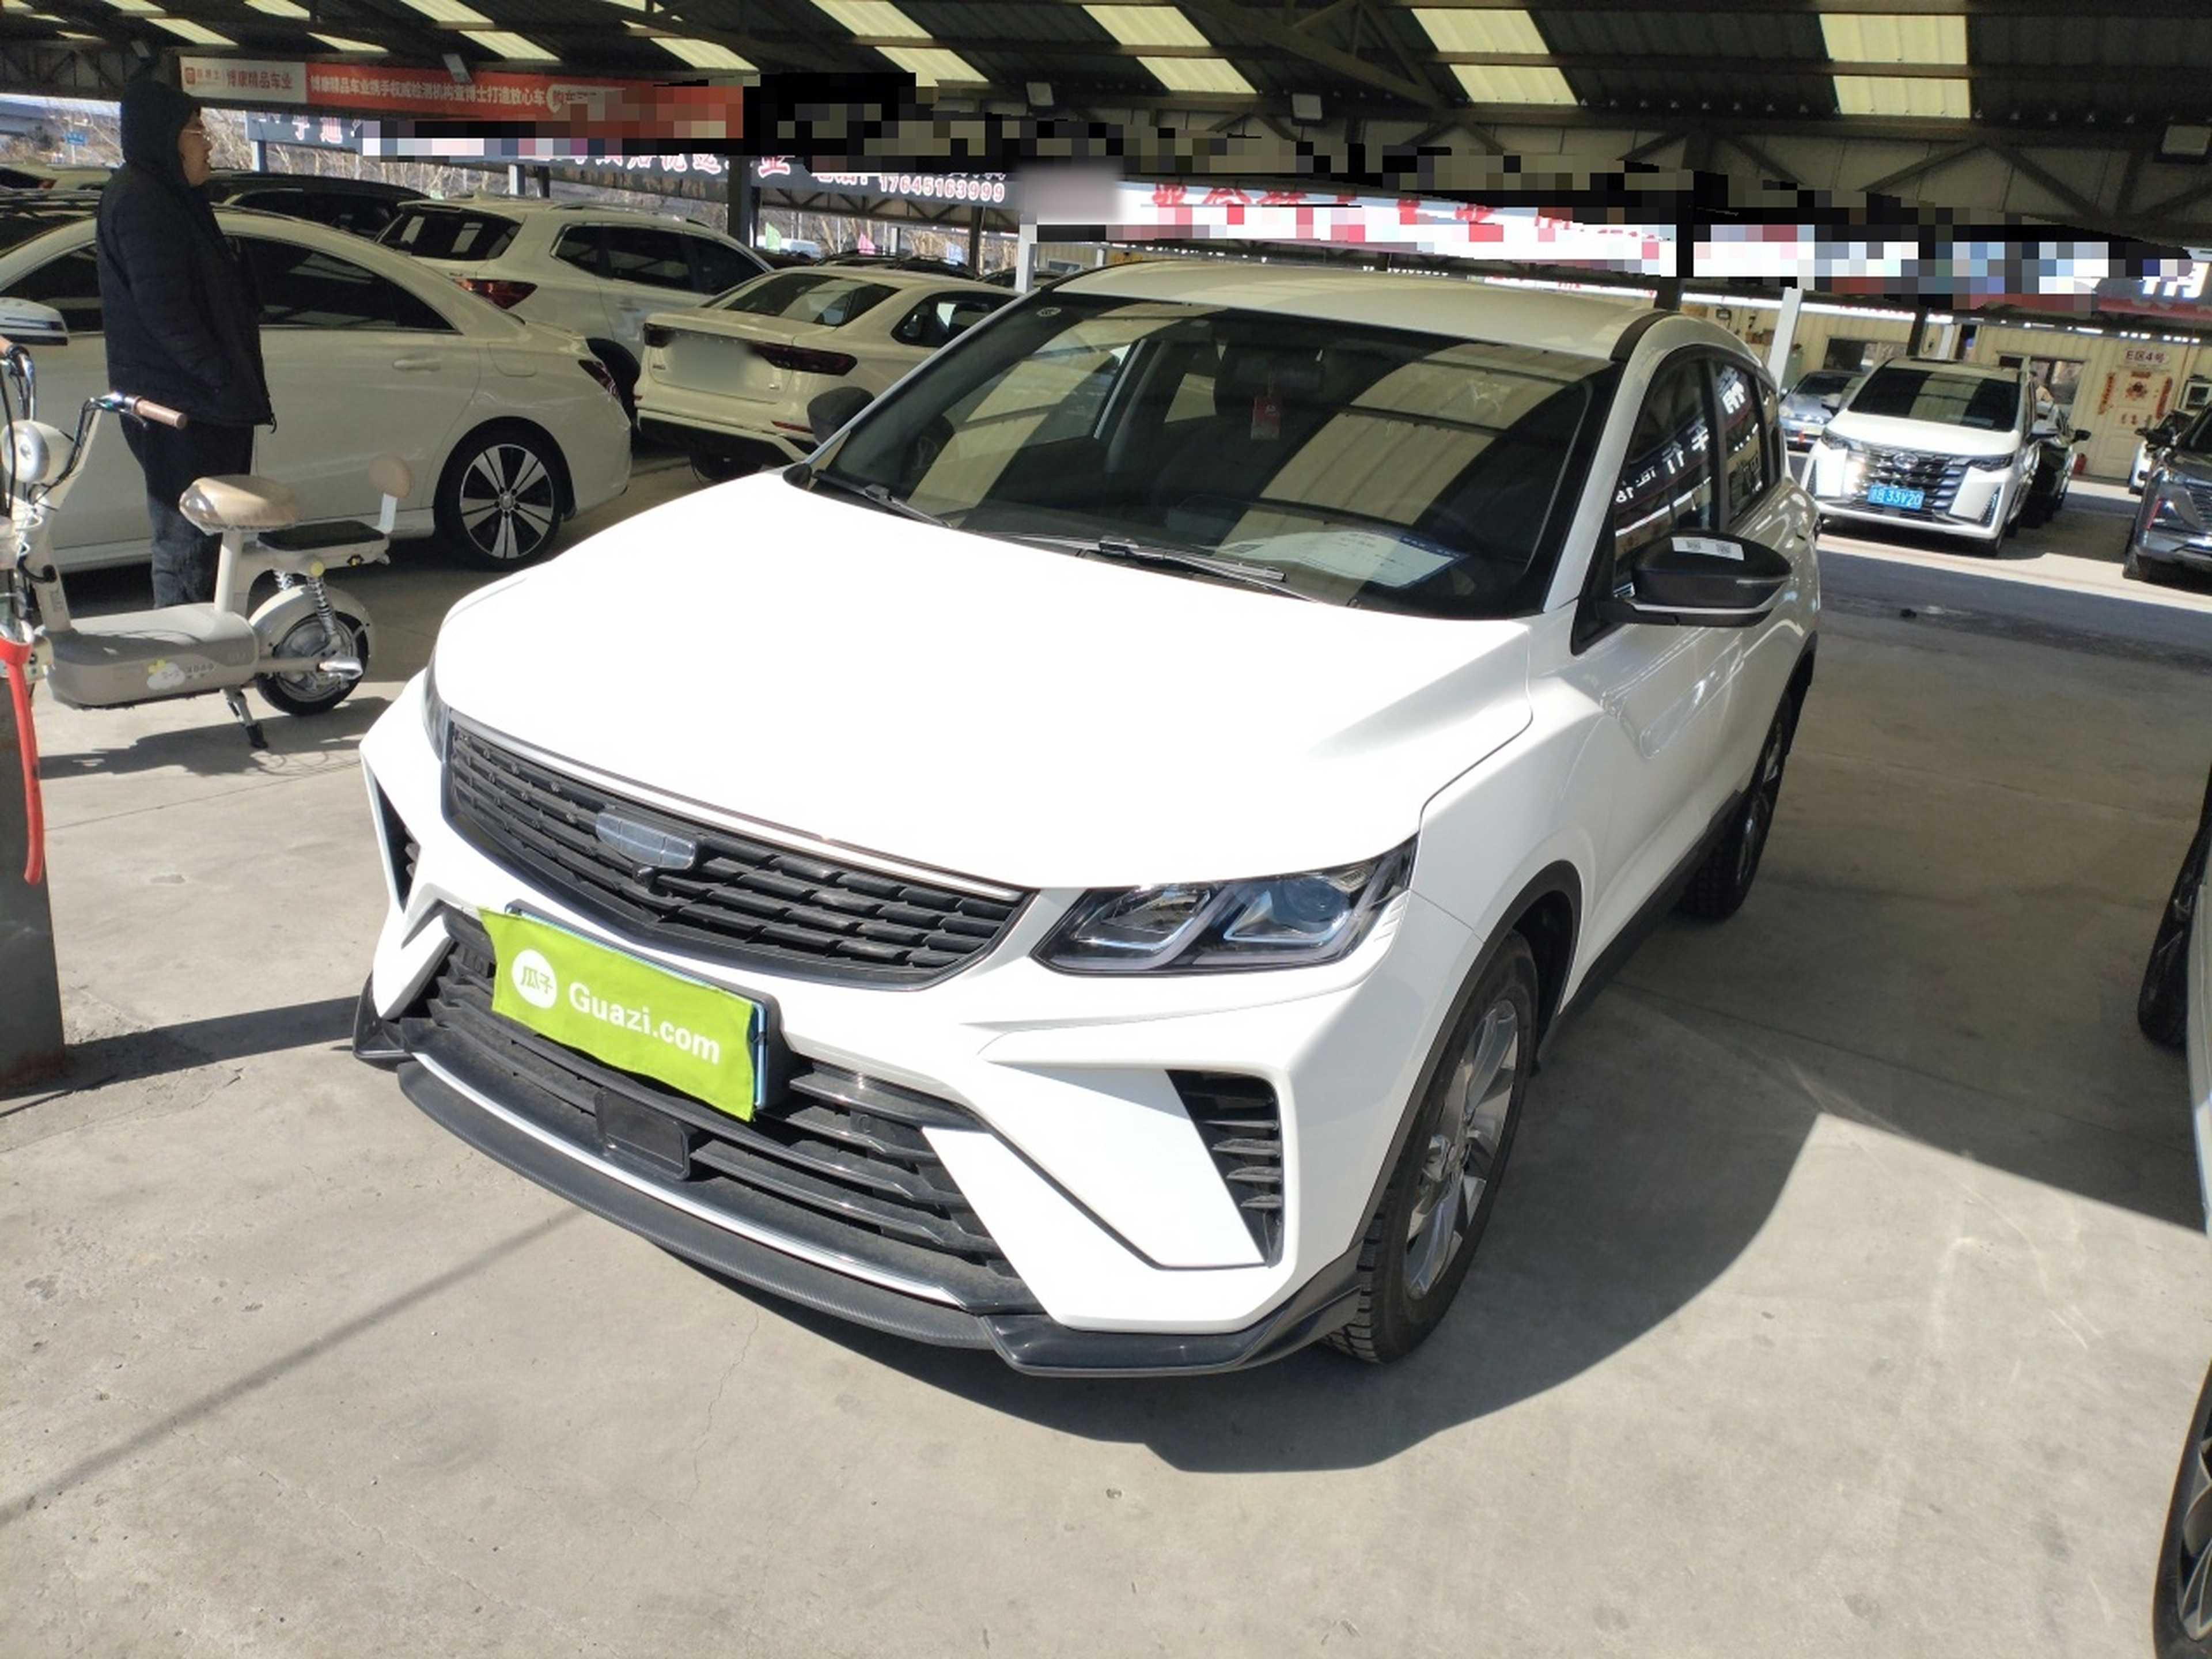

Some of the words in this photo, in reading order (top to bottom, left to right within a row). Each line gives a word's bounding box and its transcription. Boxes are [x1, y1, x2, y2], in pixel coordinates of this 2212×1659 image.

[878, 173, 1006, 203] 17645163999
[2126, 350, 2165, 363] E区4号
[520, 966, 553, 994] 瓜子
[569, 982, 720, 1065] Guazi.com
